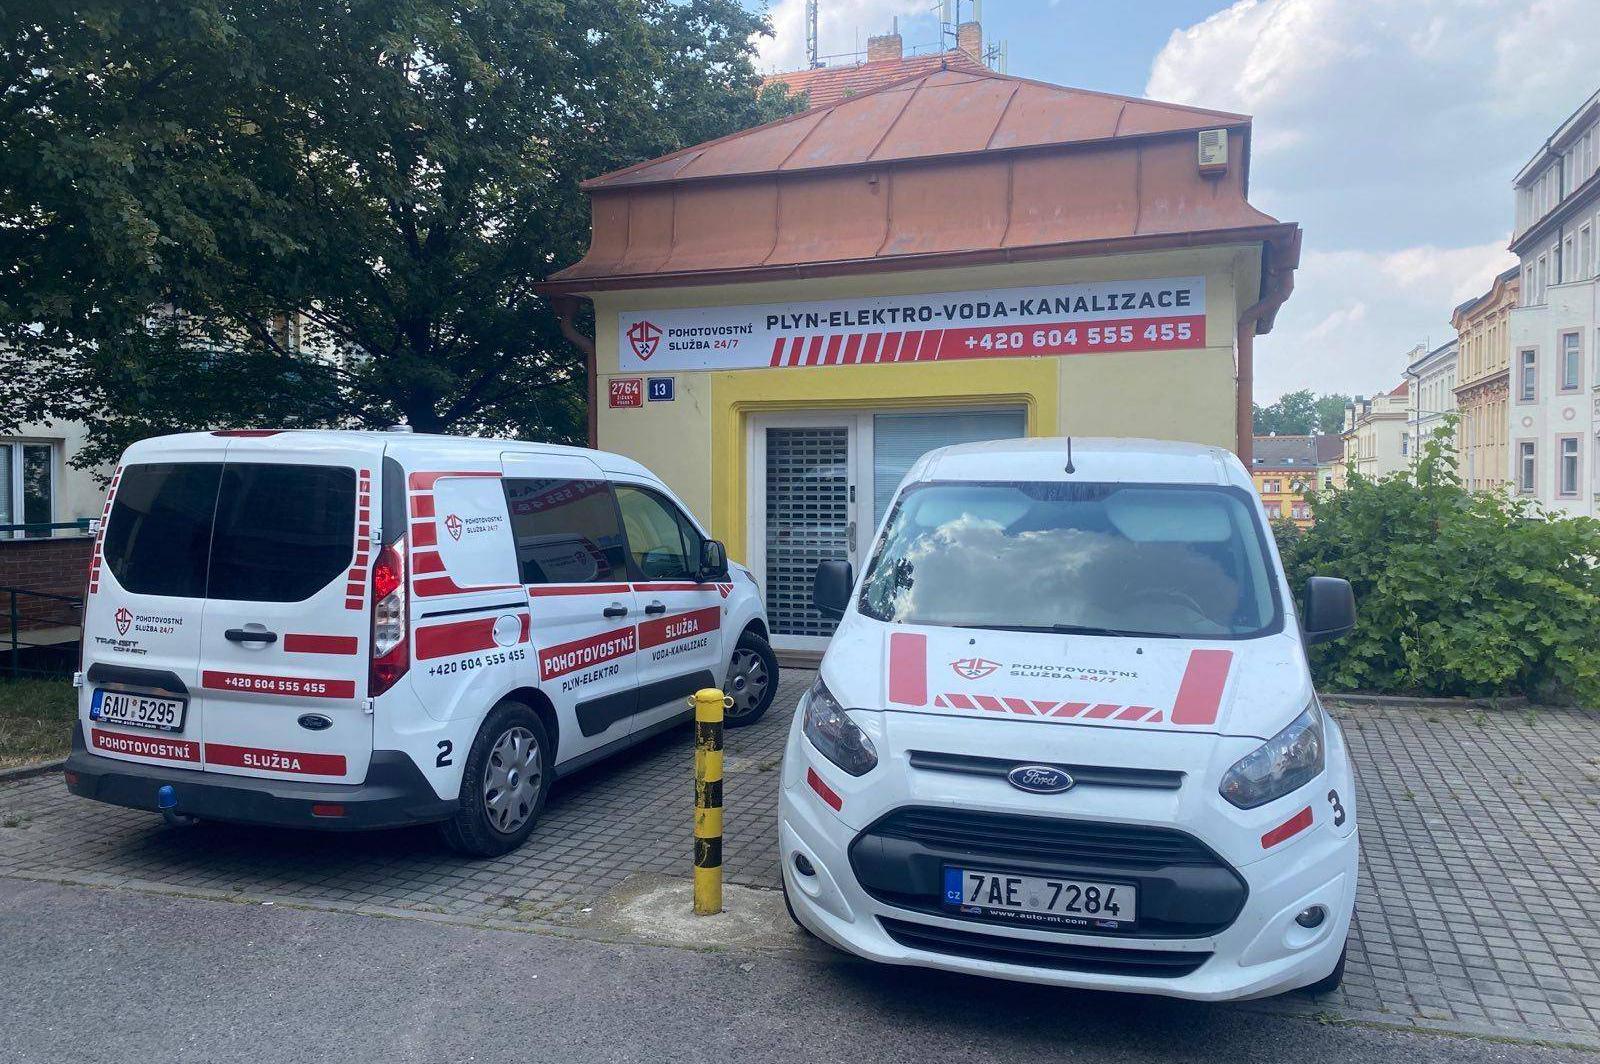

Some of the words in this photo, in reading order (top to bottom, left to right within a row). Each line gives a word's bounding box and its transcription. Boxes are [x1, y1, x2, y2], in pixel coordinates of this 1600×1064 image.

[766, 289, 1191, 330] PLYN-ELEKTRO-VODA-KANALIZACE
[668, 323, 753, 338] POHOTOVOSTNÍ
[965, 332, 1024, 350] +420
[1032, 329, 1078, 347] 604
[1088, 325, 1135, 345] 555
[1143, 323, 1192, 342] 455
[668, 339, 710, 351] SLUŽBA
[713, 339, 739, 350] 24/7
[611, 382, 639, 395] 2764
[654, 383, 666, 396] 13
[135, 615, 183, 626] POHOTOVOSTNÍ
[135, 624, 158, 633] SLUŽBA
[159, 626, 174, 634] 24/7
[544, 631, 634, 675] POHOTOVOSTNÍ
[665, 618, 699, 639] SLUŽBA
[428, 662, 457, 677] +420
[461, 657, 482, 669] 604
[486, 653, 506, 665] 555
[508, 649, 525, 661] 455
[562, 664, 620, 693] PLYN-ELEKTRO
[652, 637, 708, 662] VODA-KANALIZACE
[1011, 663, 1139, 679] POHOTOVOSTNÍ
[225, 677, 251, 688] +420
[254, 679, 275, 689] 604
[279, 681, 300, 691] 555
[303, 683, 326, 693] 455
[1079, 674, 1117, 683] 24/7
[103, 695, 129, 718] 6AU
[138, 699, 176, 724] 5295
[99, 736, 190, 759] POHOTOVOSTNÍ
[243, 753, 301, 770] SLUŽBA
[435, 739, 453, 768] 2
[1022, 769, 1058, 786] Ford
[1327, 789, 1346, 827] 3
[947, 890, 961, 900] CZ
[969, 874, 1022, 907] 7AE
[1046, 882, 1121, 917] 7284
[988, 908, 1088, 926] www.auto-mt.com
